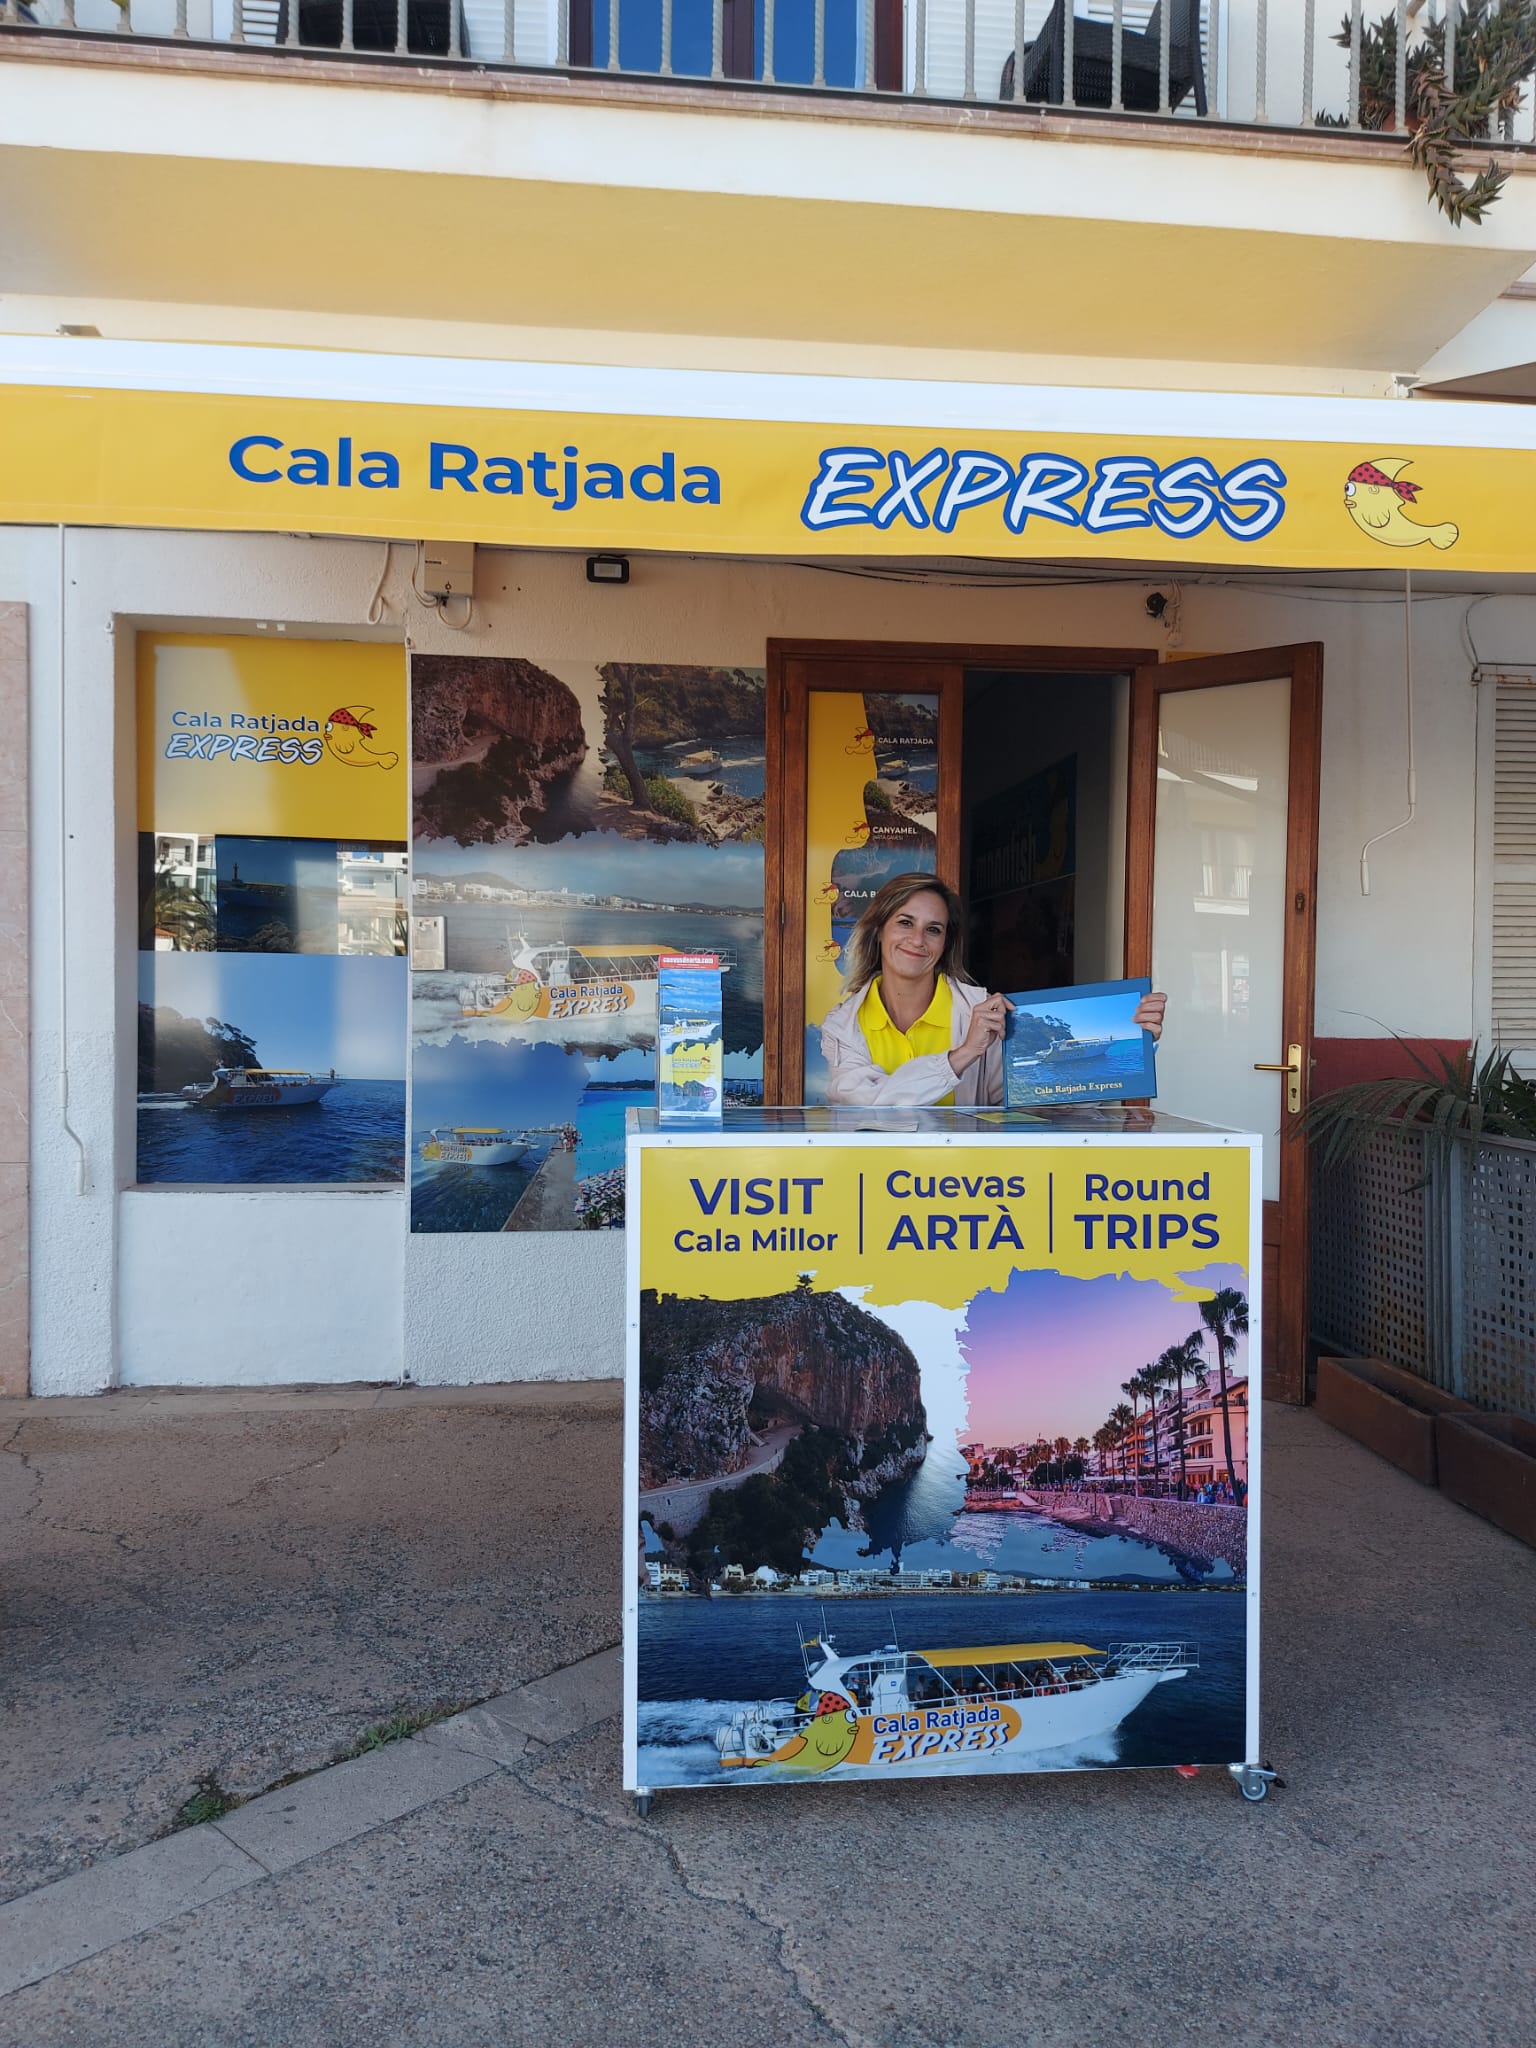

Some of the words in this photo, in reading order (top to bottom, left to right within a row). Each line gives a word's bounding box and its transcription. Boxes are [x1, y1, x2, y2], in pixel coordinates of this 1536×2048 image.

[229, 435, 400, 488] Cala
[428, 442, 721, 510] Ratjada
[801, 447, 1286, 541] EXPRESS
[172, 711, 221, 728] Cala
[231, 712, 319, 733] Ratjada
[165, 733, 323, 765] EXPRESS
[878, 737, 897, 745] CALA
[872, 826, 917, 834] CANYAMEL
[844, 890, 867, 898] CALA
[550, 988, 577, 999] Cala
[580, 984, 623, 997] Ratjada
[548, 996, 628, 1018] EXPRESS
[1034, 1087, 1053, 1095] Cala
[1055, 1084, 1086, 1094] Ratjada
[1088, 1081, 1123, 1092] Express
[689, 1177, 824, 1215] VISIT
[886, 1169, 1026, 1198] Cuevas
[1084, 1171, 1210, 1201] Round
[674, 1228, 740, 1252] Cala
[752, 1227, 838, 1252] Millor
[886, 1204, 1025, 1251] ARTÀ
[1074, 1213, 1221, 1249] TRIPS
[873, 1716, 920, 1735] Cala
[926, 1705, 1001, 1729] Ratjada
[869, 1723, 1010, 1764] EXPRESS
